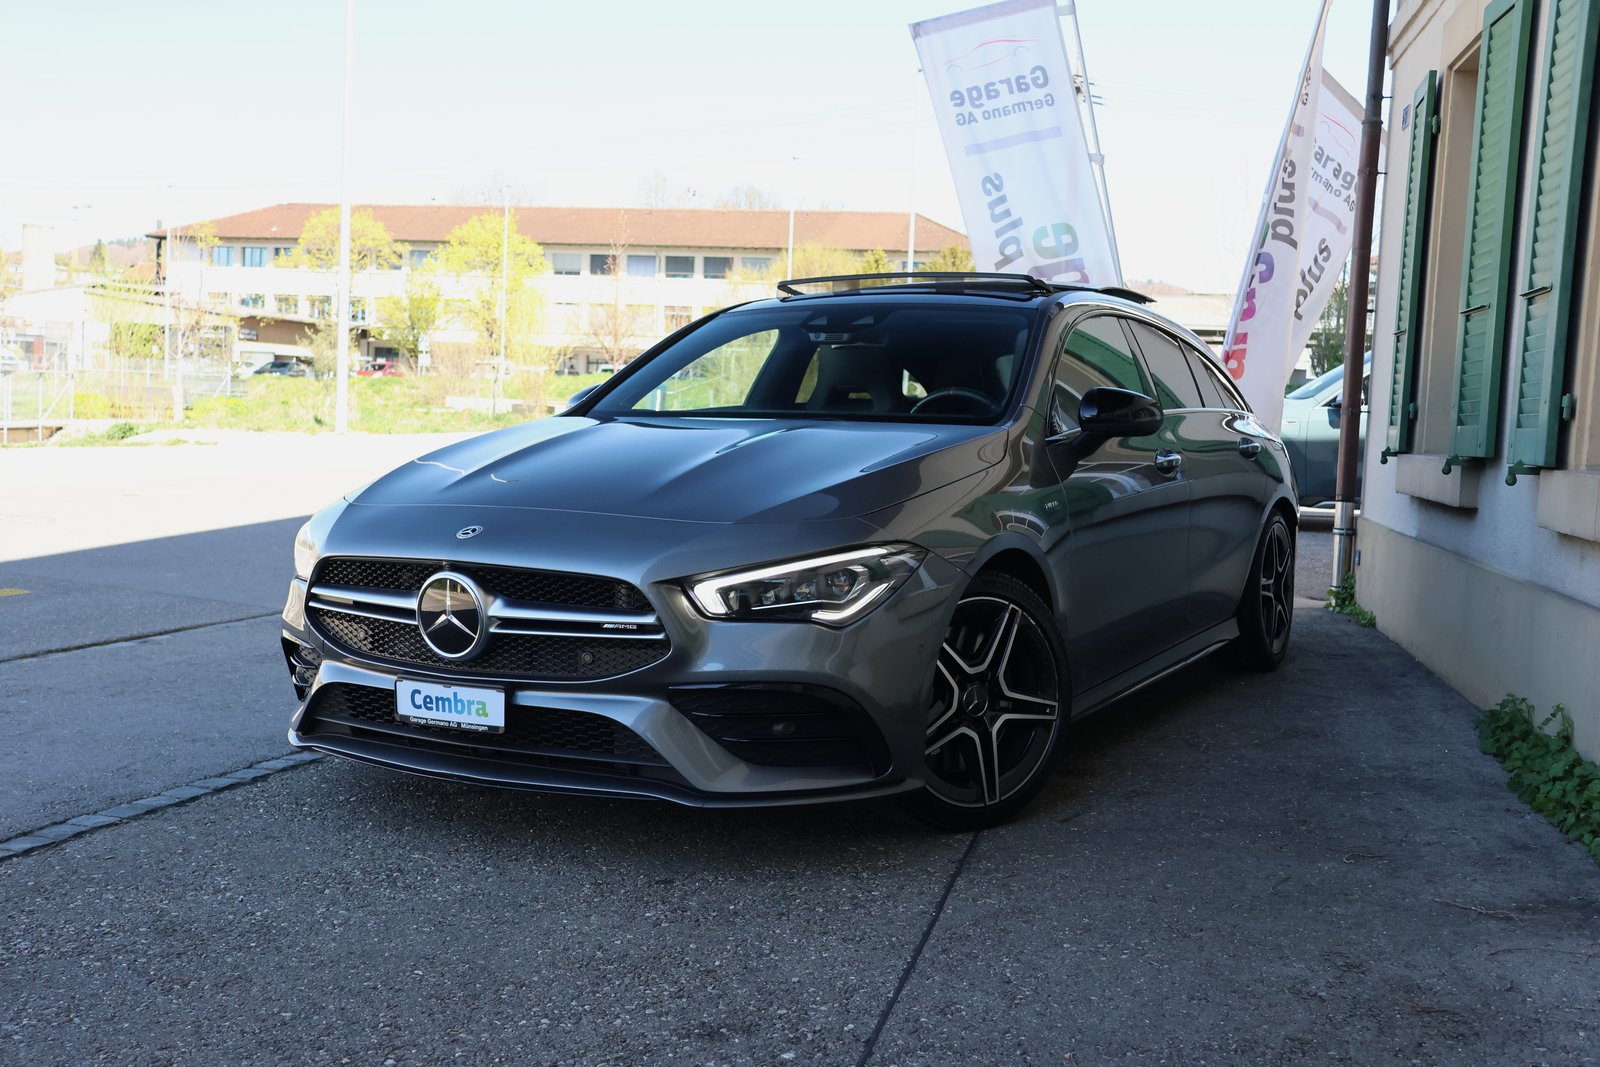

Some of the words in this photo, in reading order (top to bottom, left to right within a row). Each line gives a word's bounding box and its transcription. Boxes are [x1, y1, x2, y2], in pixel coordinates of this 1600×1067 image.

[1313, 136, 1359, 192] arag
[1293, 237, 1332, 321] plus
[410, 689, 489, 717] Cembra
[427, 719, 448, 727] Germano
